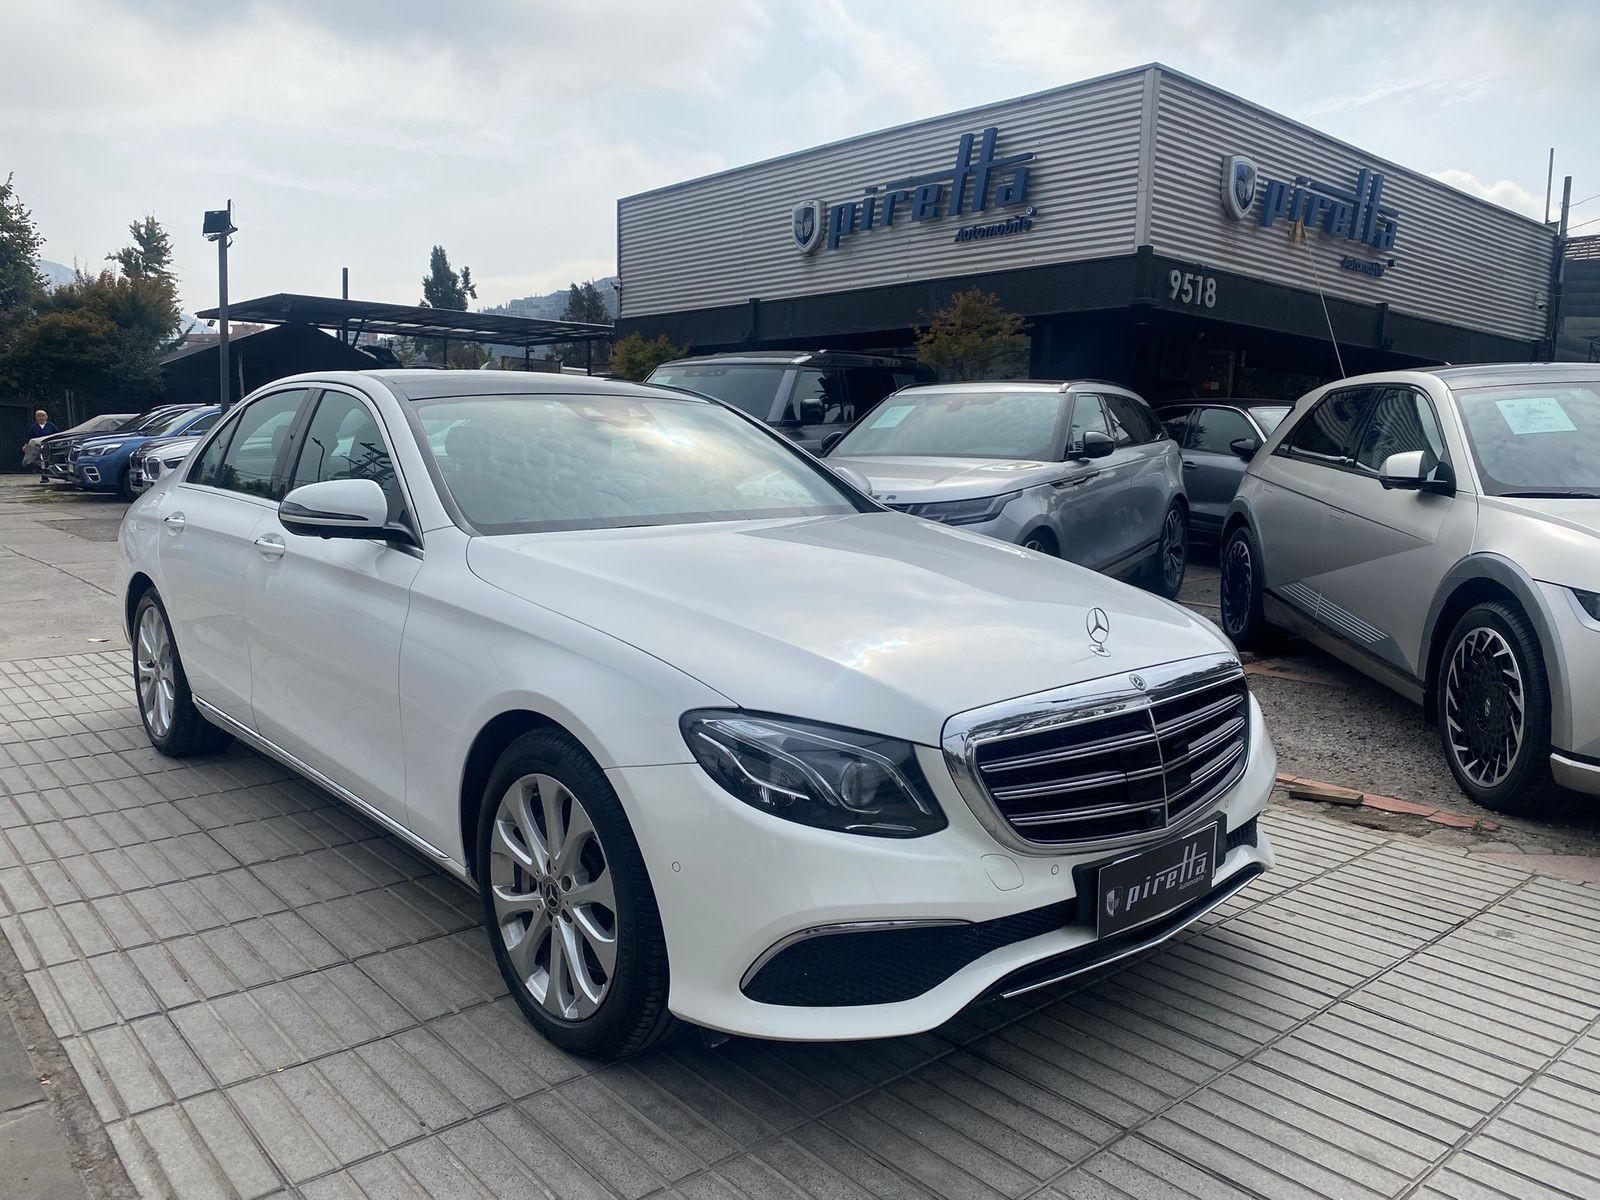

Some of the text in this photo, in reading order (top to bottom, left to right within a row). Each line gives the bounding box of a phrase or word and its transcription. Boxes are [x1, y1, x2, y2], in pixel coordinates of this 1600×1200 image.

[827, 127, 1036, 250] piretta
[1259, 168, 1399, 251] piretta
[1168, 269, 1217, 309] 9518
[1126, 843, 1207, 911] piretta
